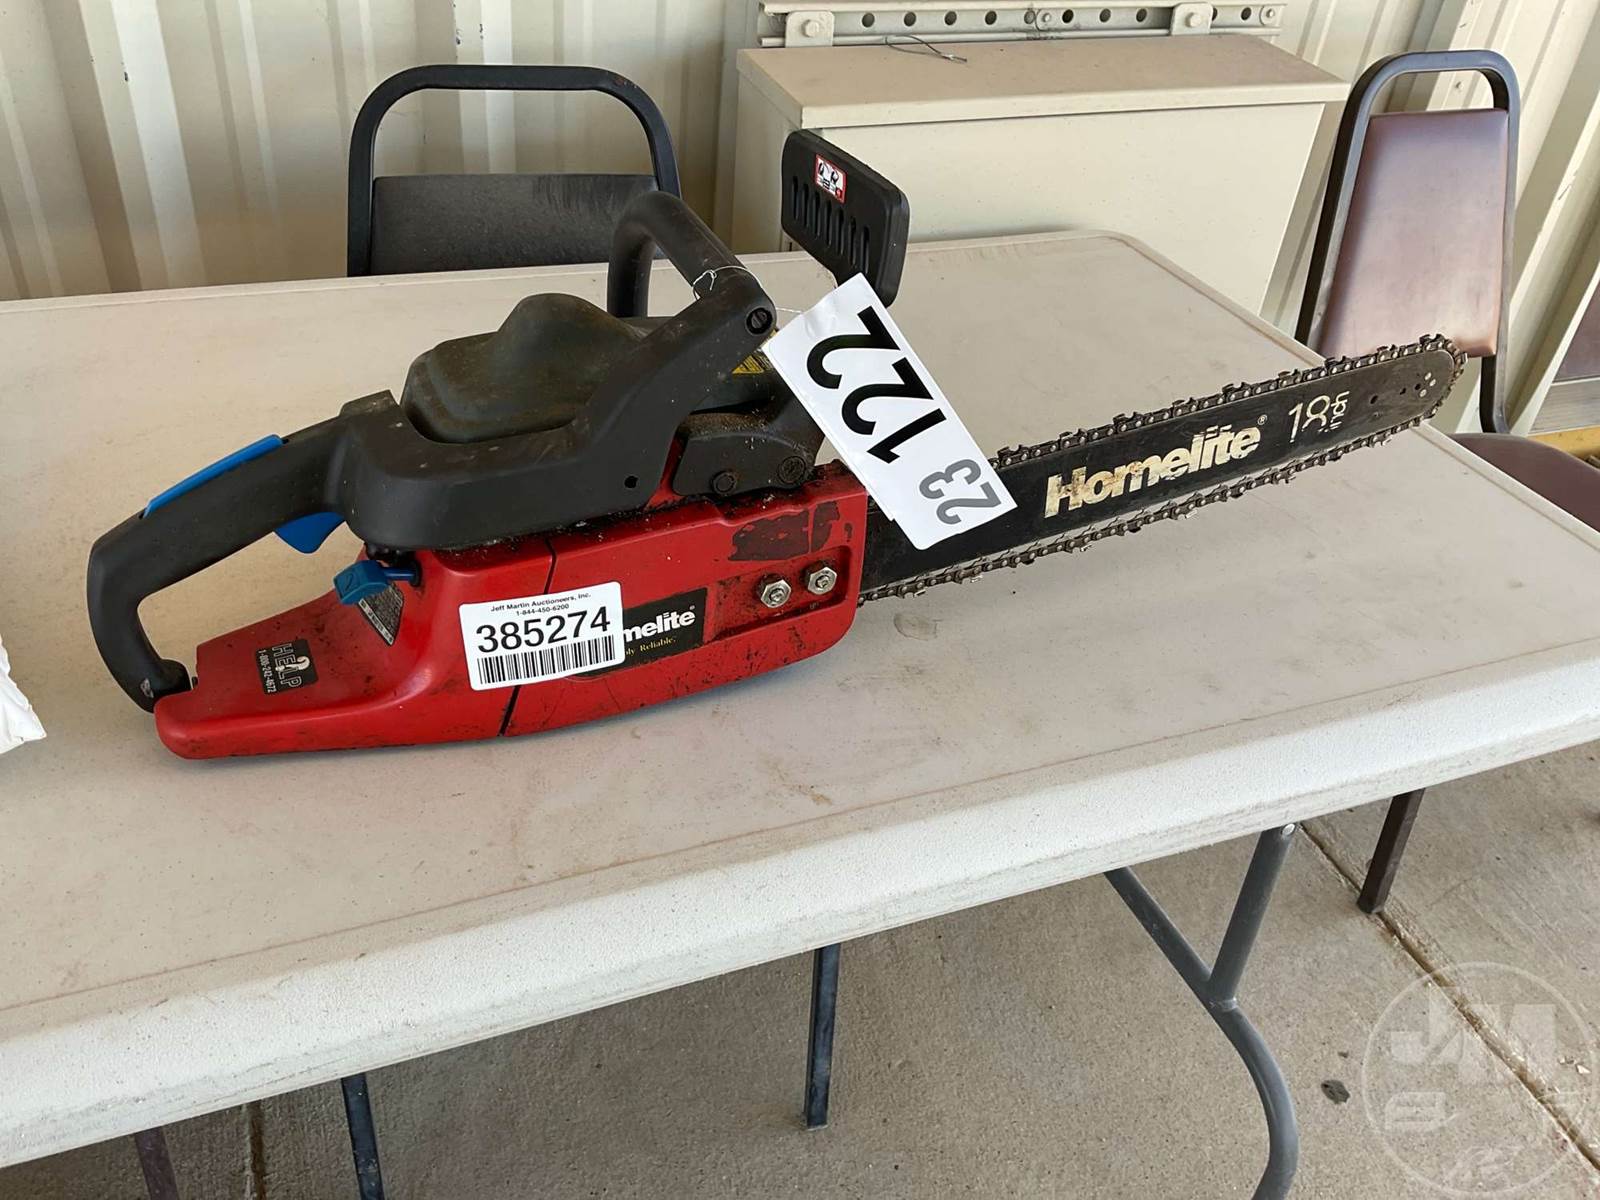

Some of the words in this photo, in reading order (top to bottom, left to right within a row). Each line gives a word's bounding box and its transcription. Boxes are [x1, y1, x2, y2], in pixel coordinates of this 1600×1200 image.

[806, 305, 947, 464] 122
[1044, 424, 1261, 518] Homelite
[1288, 395, 1331, 443] 18
[919, 458, 1002, 525] 23
[490, 604, 505, 612] Jeff
[506, 602, 530, 610] Martin
[531, 596, 577, 606] Auctioneers,
[516, 603, 570, 616] 1-844-450-6200
[622, 611, 696, 643] melite
[475, 605, 611, 654] 385274
